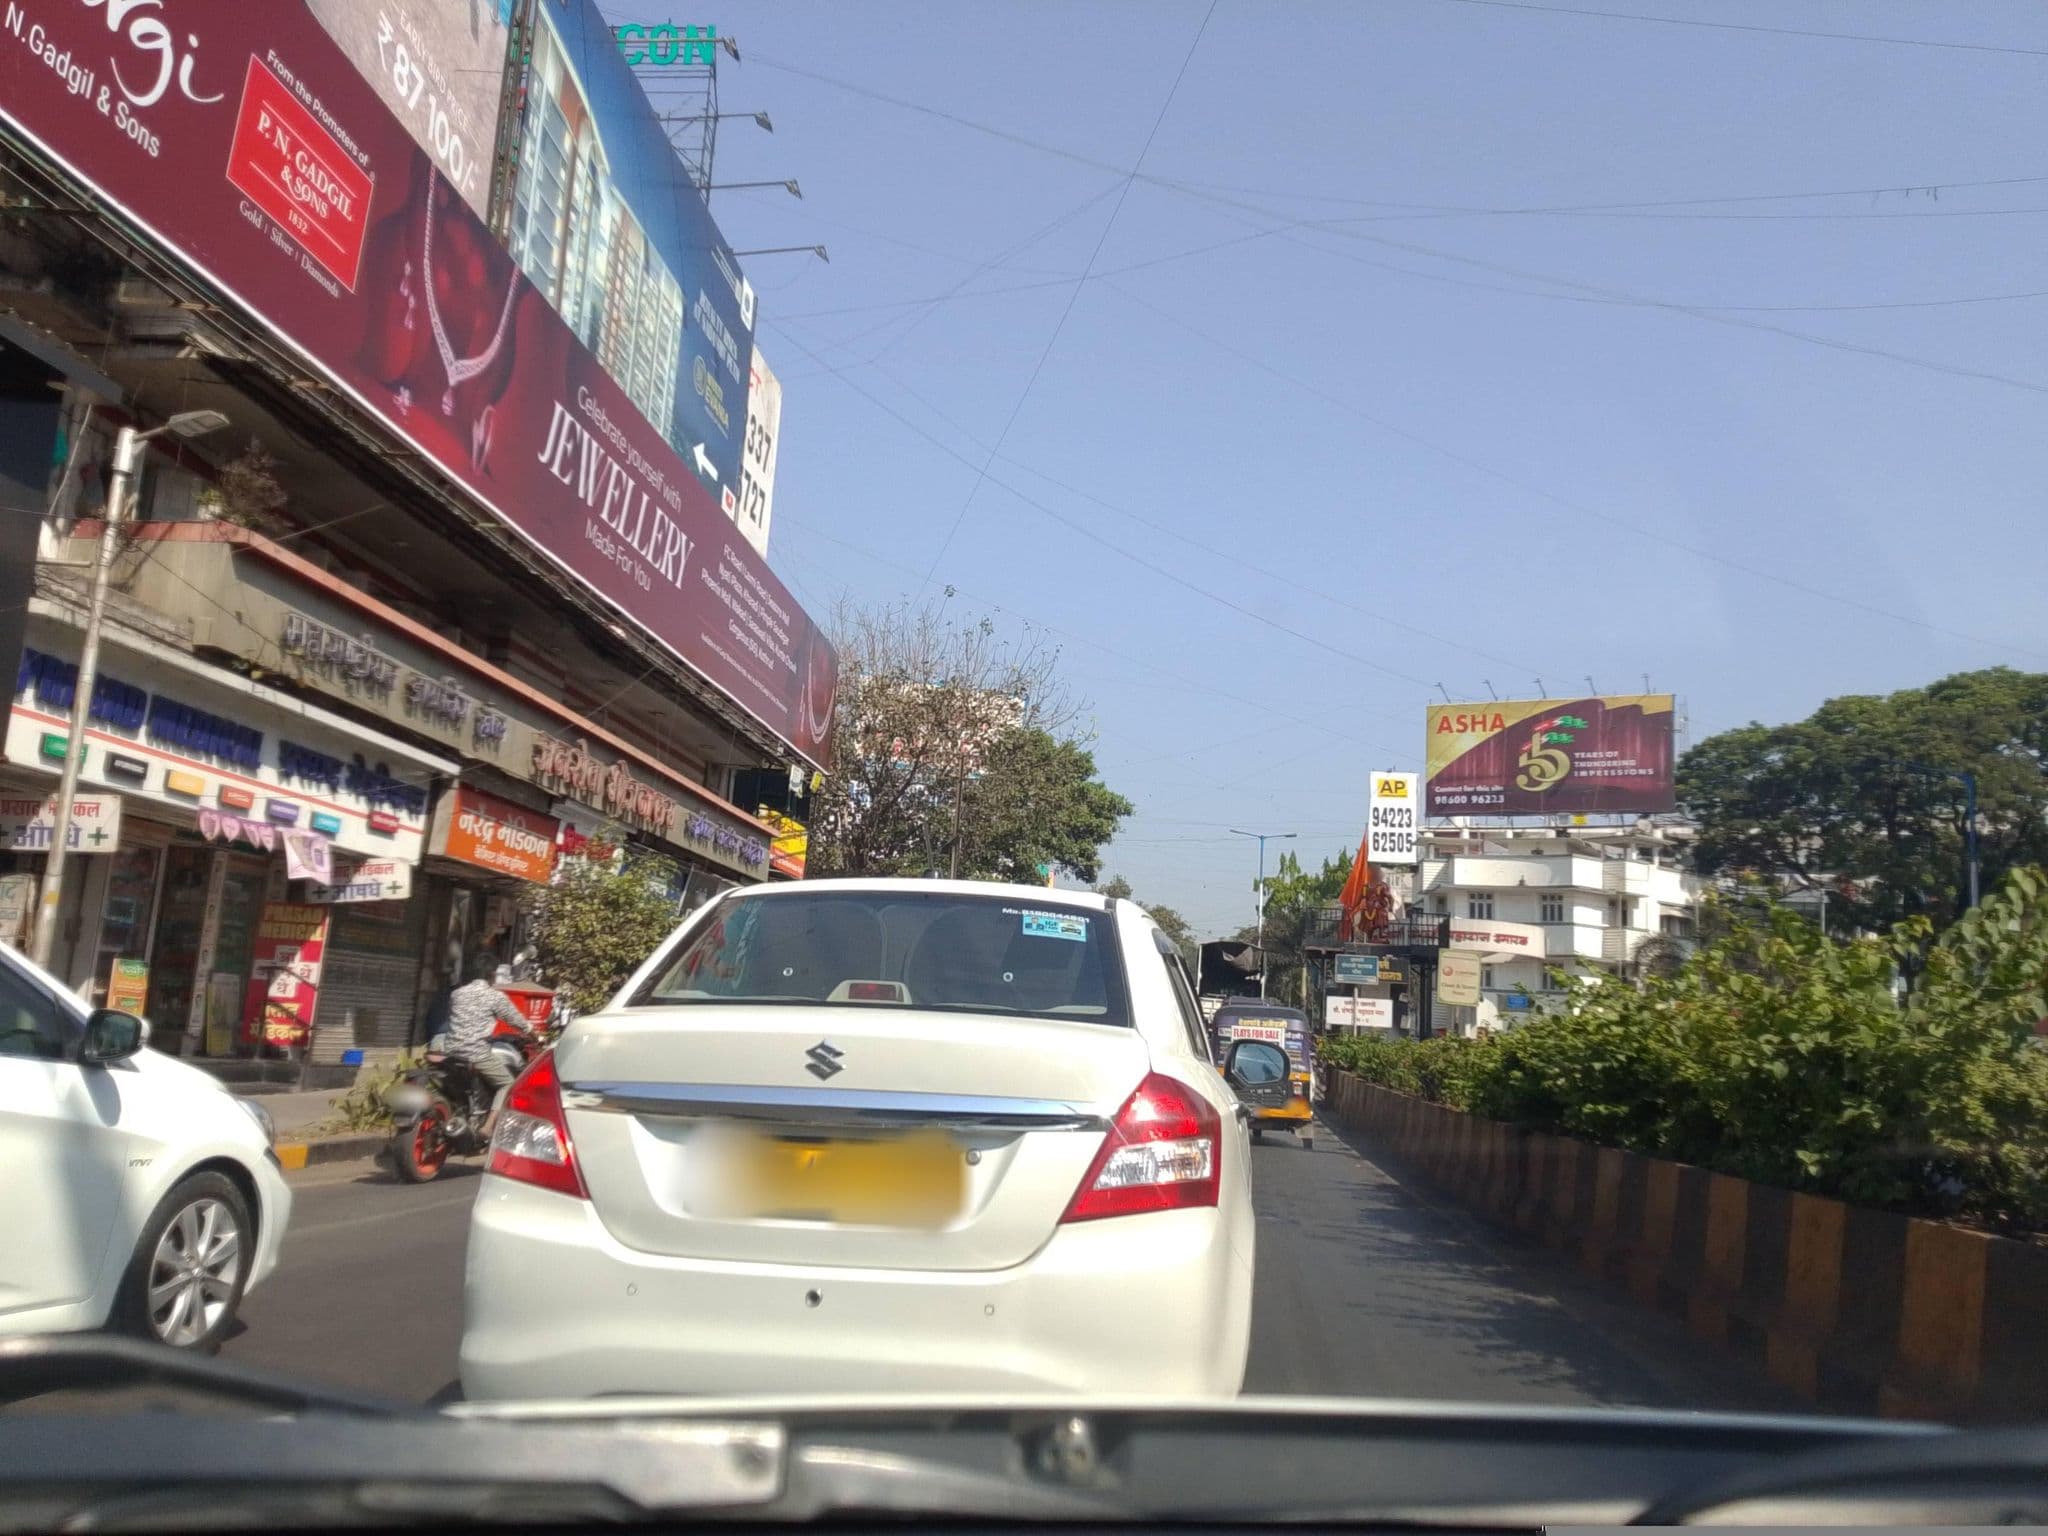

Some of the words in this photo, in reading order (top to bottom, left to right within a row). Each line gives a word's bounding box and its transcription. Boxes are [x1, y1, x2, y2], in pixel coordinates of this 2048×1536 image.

[82, 0, 224, 106] rgi
[96, 85, 111, 117] &
[114, 100, 160, 158] Sons
[267, 49, 294, 87] From
[295, 79, 312, 104] the
[313, 98, 358, 156] Promoters
[358, 151, 369, 167] of
[288, 208, 310, 235] 1832
[294, 176, 330, 219] SONS
[295, 150, 353, 222] GADGIL
[239, 199, 263, 229] Gold
[269, 226, 295, 256] Silver
[300, 253, 341, 299] Diamonds
[577, 386, 629, 454] Celebrate
[624, 440, 662, 491] yourself
[660, 479, 683, 513] with
[538, 399, 696, 590] JEWELLERY
[584, 518, 616, 562] Made
[613, 545, 634, 573] For
[632, 557, 652, 592] You
[1436, 713, 1506, 735] ASHA
[1372, 807, 1412, 828] 94223
[1380, 780, 1406, 794] AP
[1372, 832, 1412, 853] 62505
[1252, 1029, 1263, 1038] FOR
[1265, 1029, 1279, 1039] SALE
